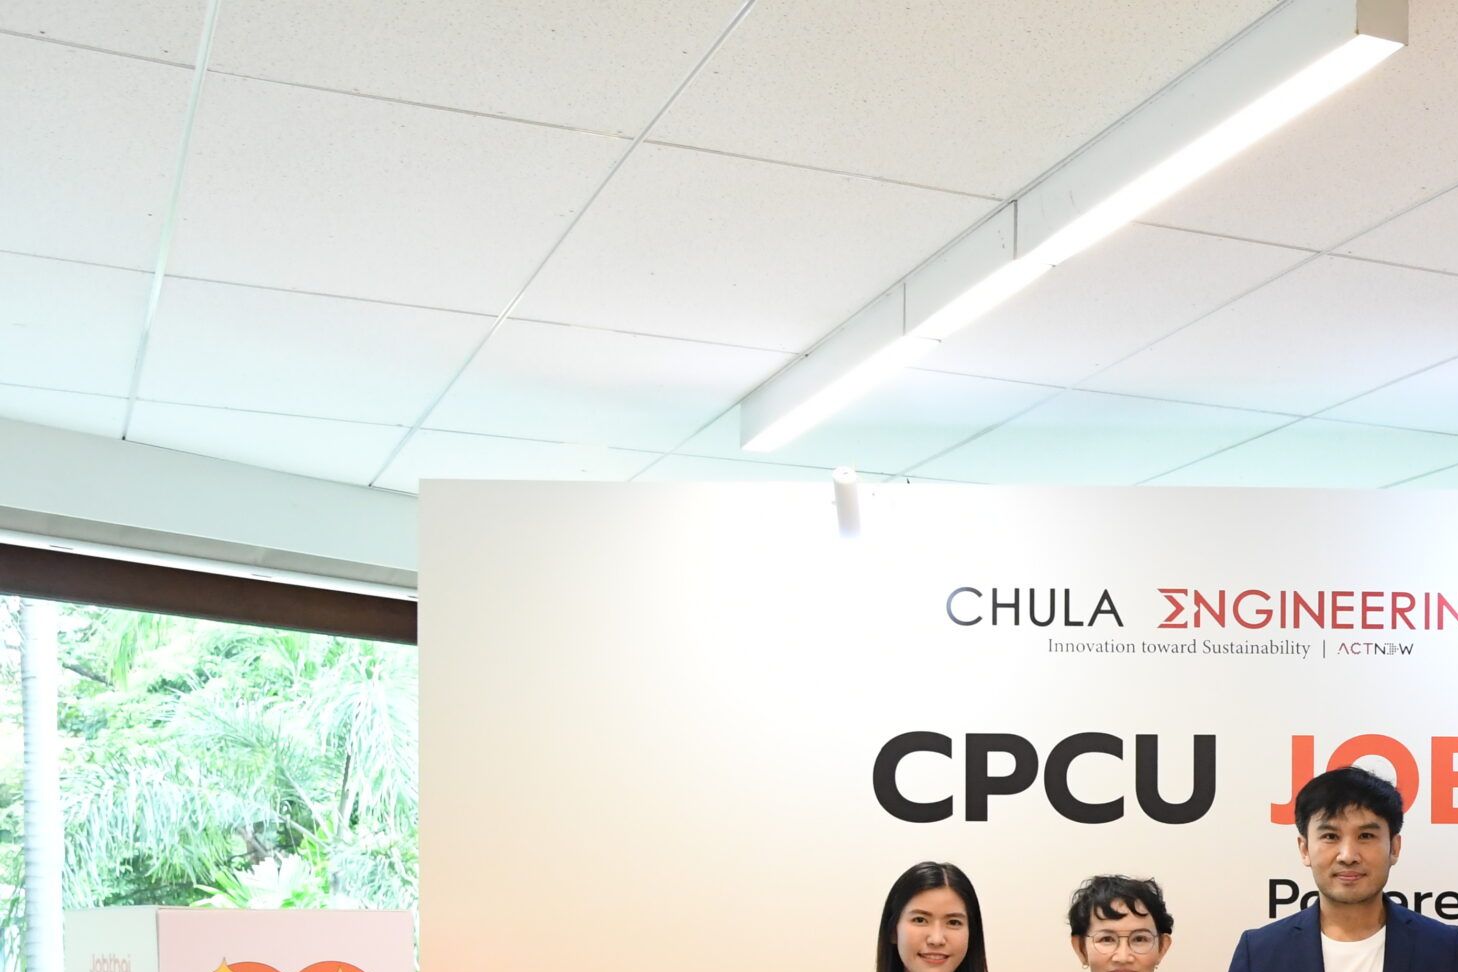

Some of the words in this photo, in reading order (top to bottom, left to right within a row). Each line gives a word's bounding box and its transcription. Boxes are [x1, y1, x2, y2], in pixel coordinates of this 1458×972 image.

[946, 586, 1124, 628] CHULA
[1048, 639, 1136, 654] Innovation
[1141, 639, 1197, 654] toward
[1202, 639, 1311, 659] Sustainability
[872, 731, 1216, 825] CPCU
